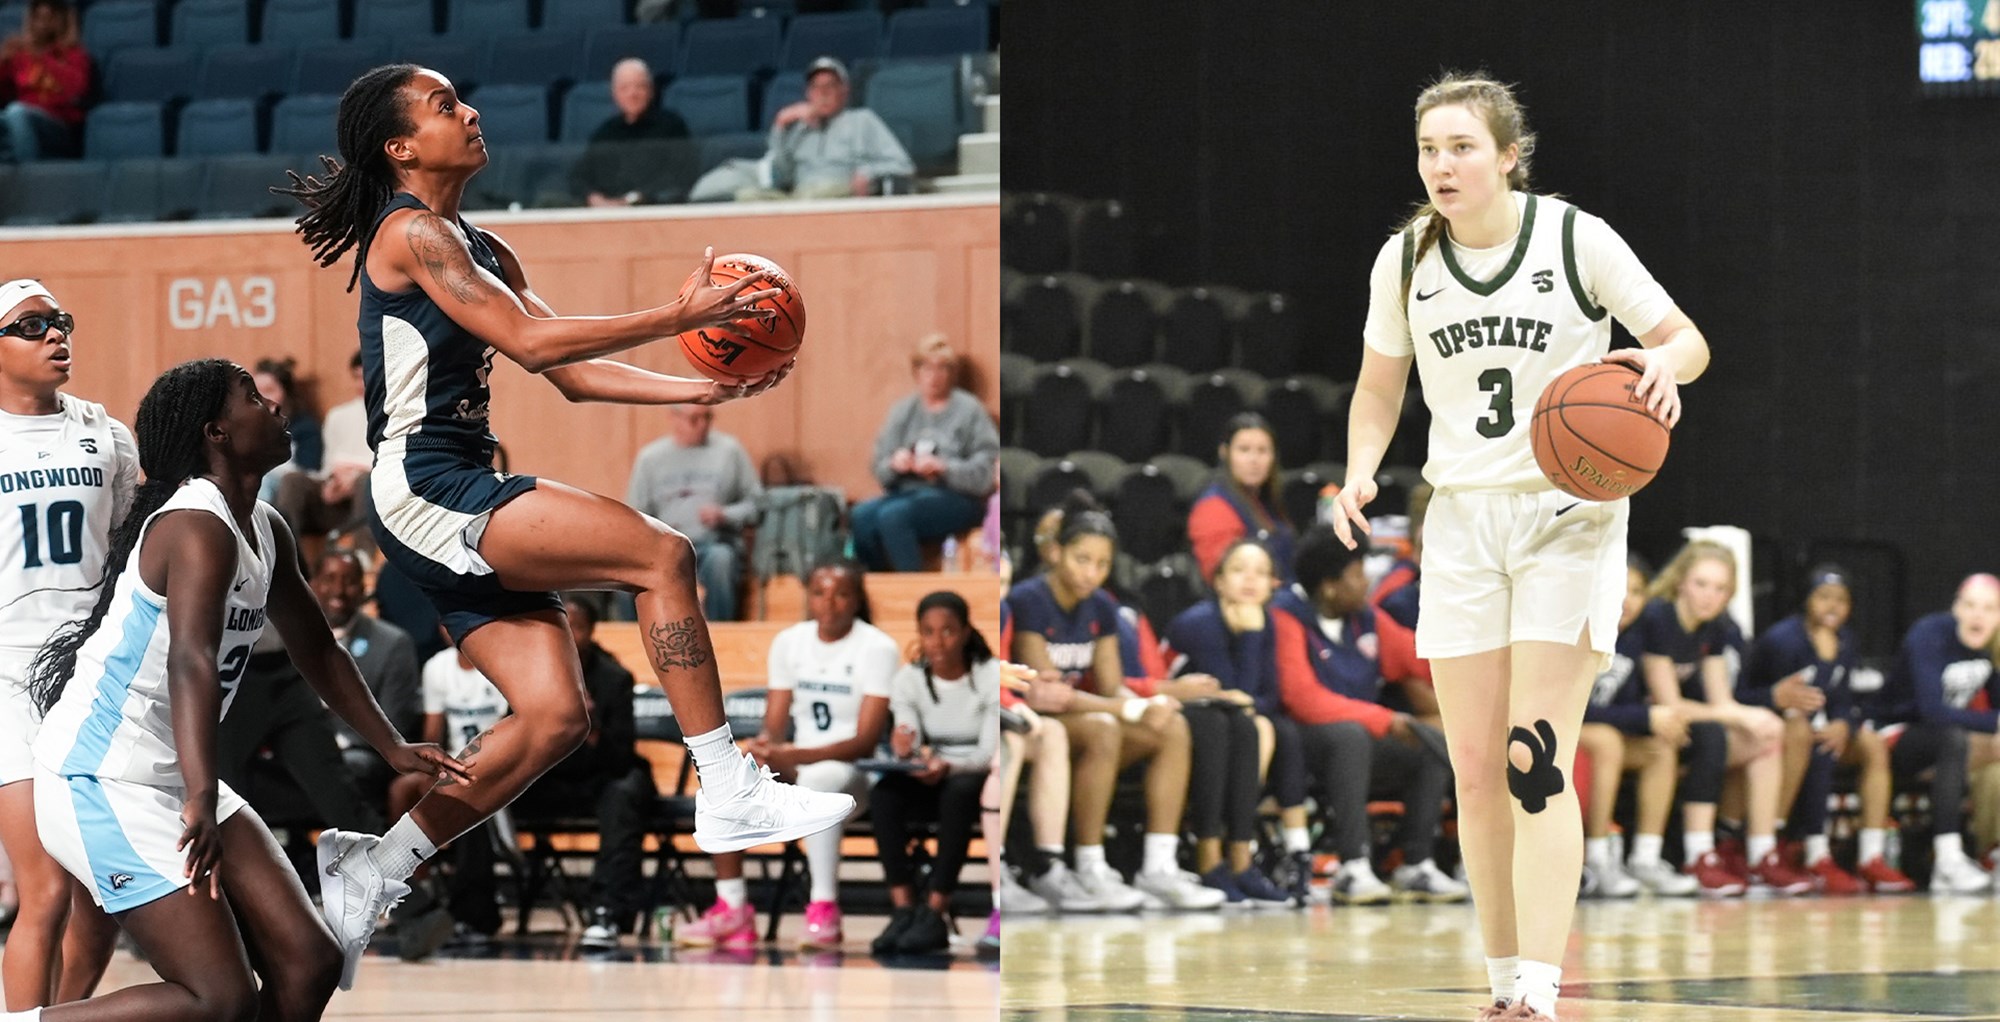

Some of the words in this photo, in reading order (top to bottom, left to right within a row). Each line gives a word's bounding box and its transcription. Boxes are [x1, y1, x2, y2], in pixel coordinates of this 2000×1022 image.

[168, 276, 276, 330] GA3
[1429, 316, 1553, 358] UPSTATE
[1476, 367, 1516, 439] 3
[0, 467, 103, 494] ONGWOOD
[18, 500, 84, 569] 10
